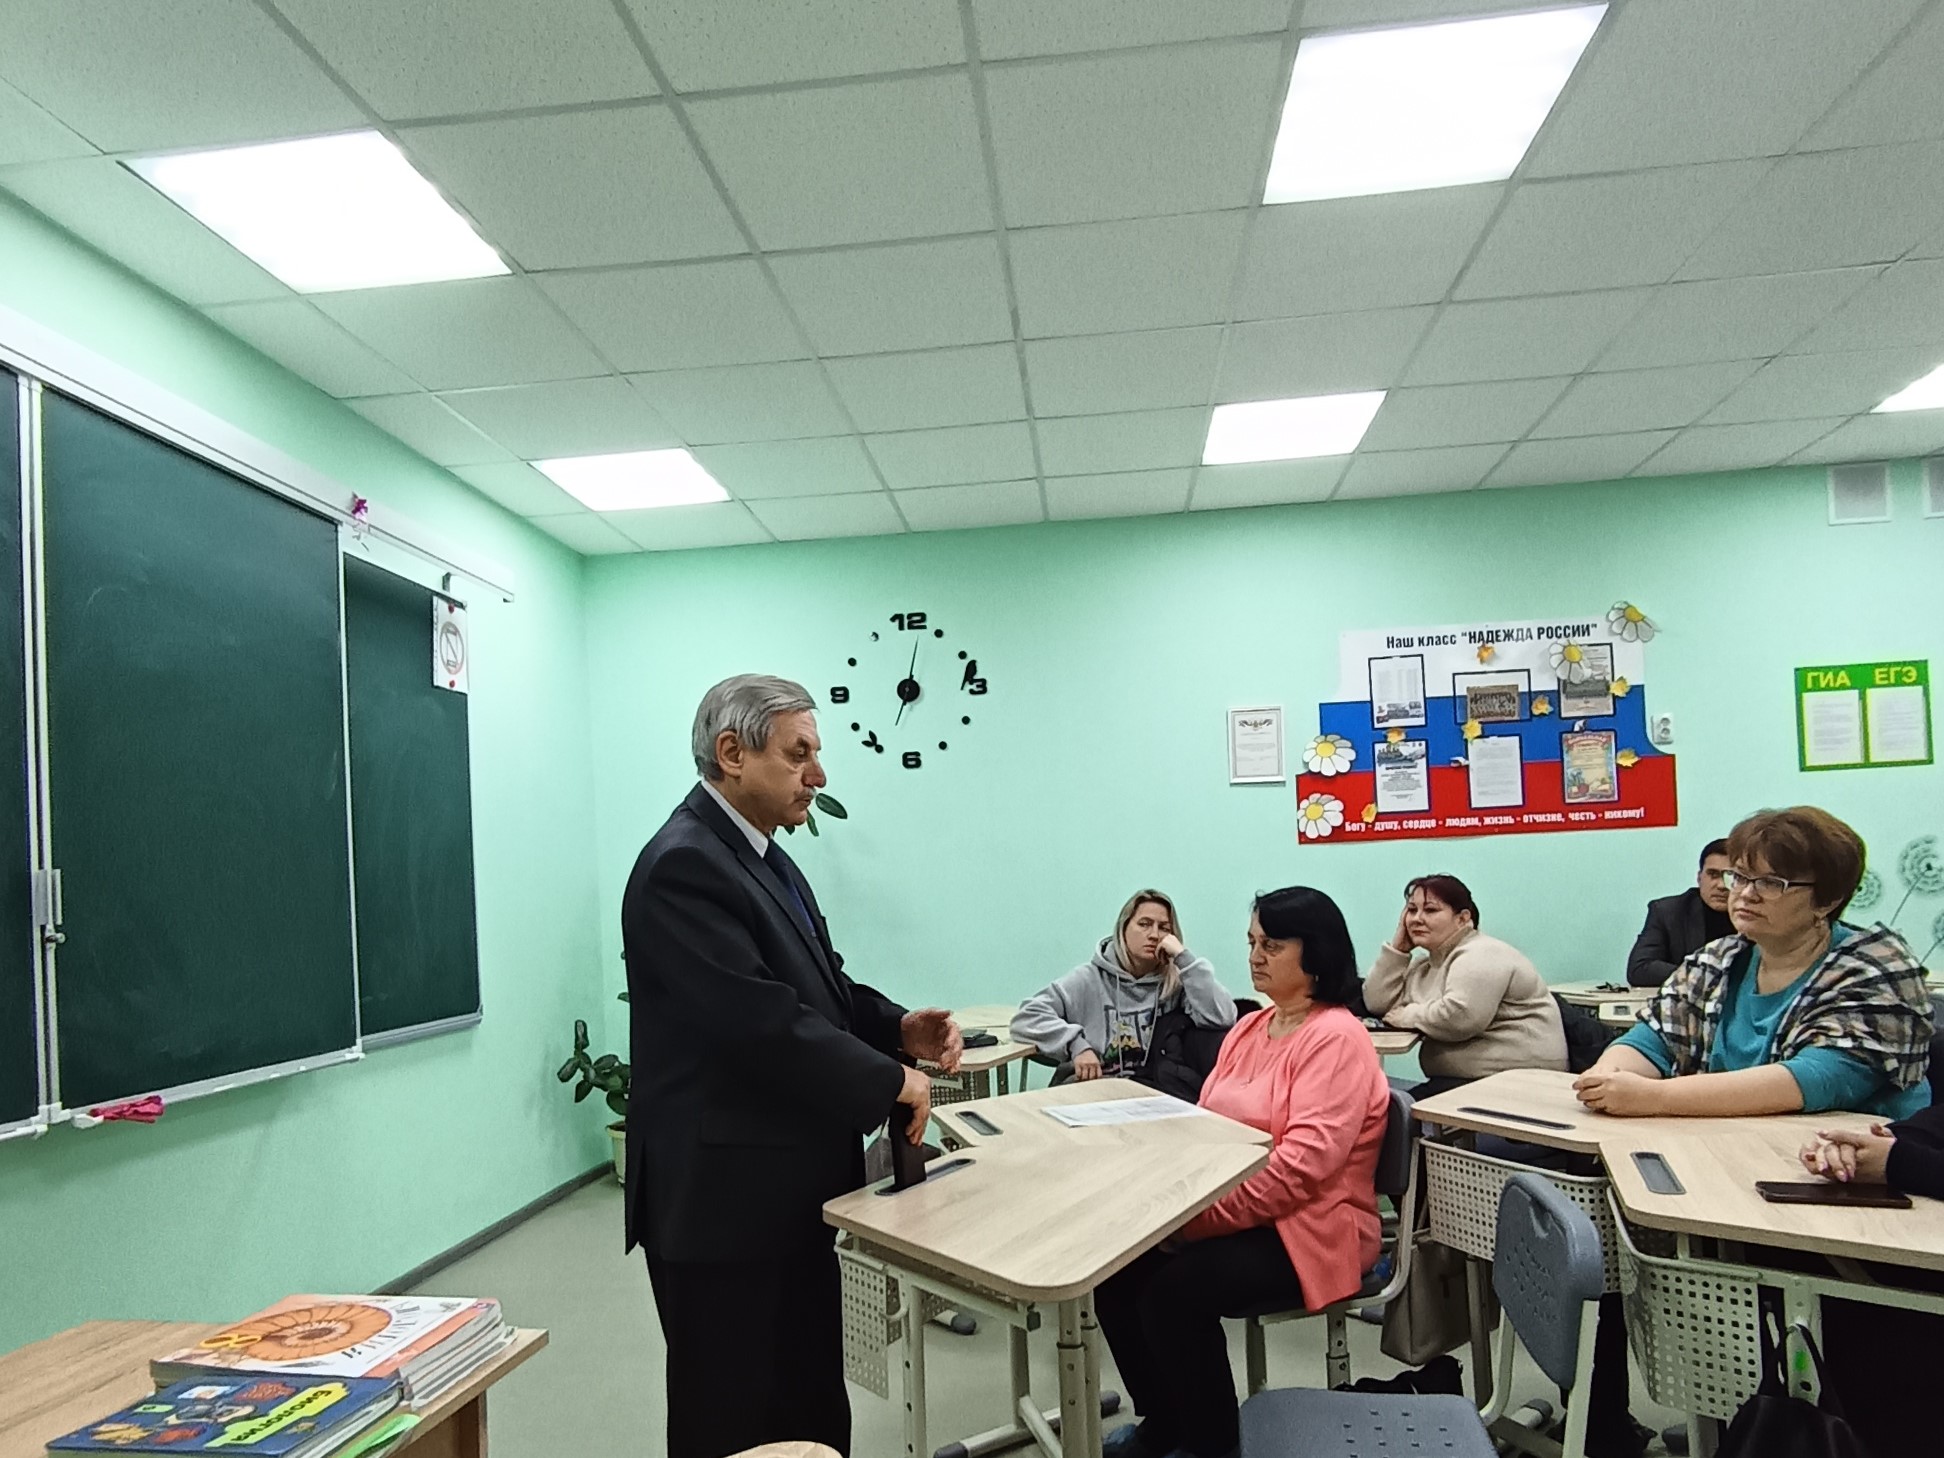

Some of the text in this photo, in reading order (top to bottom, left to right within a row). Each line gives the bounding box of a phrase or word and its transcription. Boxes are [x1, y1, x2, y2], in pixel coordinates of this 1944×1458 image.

[889, 612, 927, 631] 12
[1386, 623, 1598, 649] Наш класс "НАДЕЖДА РОССИИ"
[968, 678, 988, 695] 3
[1806, 666, 1918, 689] ГИА ЕГЭ
[830, 686, 850, 704] 9
[902, 751, 922, 769] 6
[1345, 821, 1366, 832] Богу
[1374, 820, 1401, 831] душу,
[1402, 818, 1436, 830] сердце
[1445, 816, 1482, 828] людям,
[1483, 815, 1515, 826] жизнь
[1522, 812, 1566, 823] отчизне,
[1568, 811, 1597, 821] честь
[1604, 806, 1645, 820] никому!
